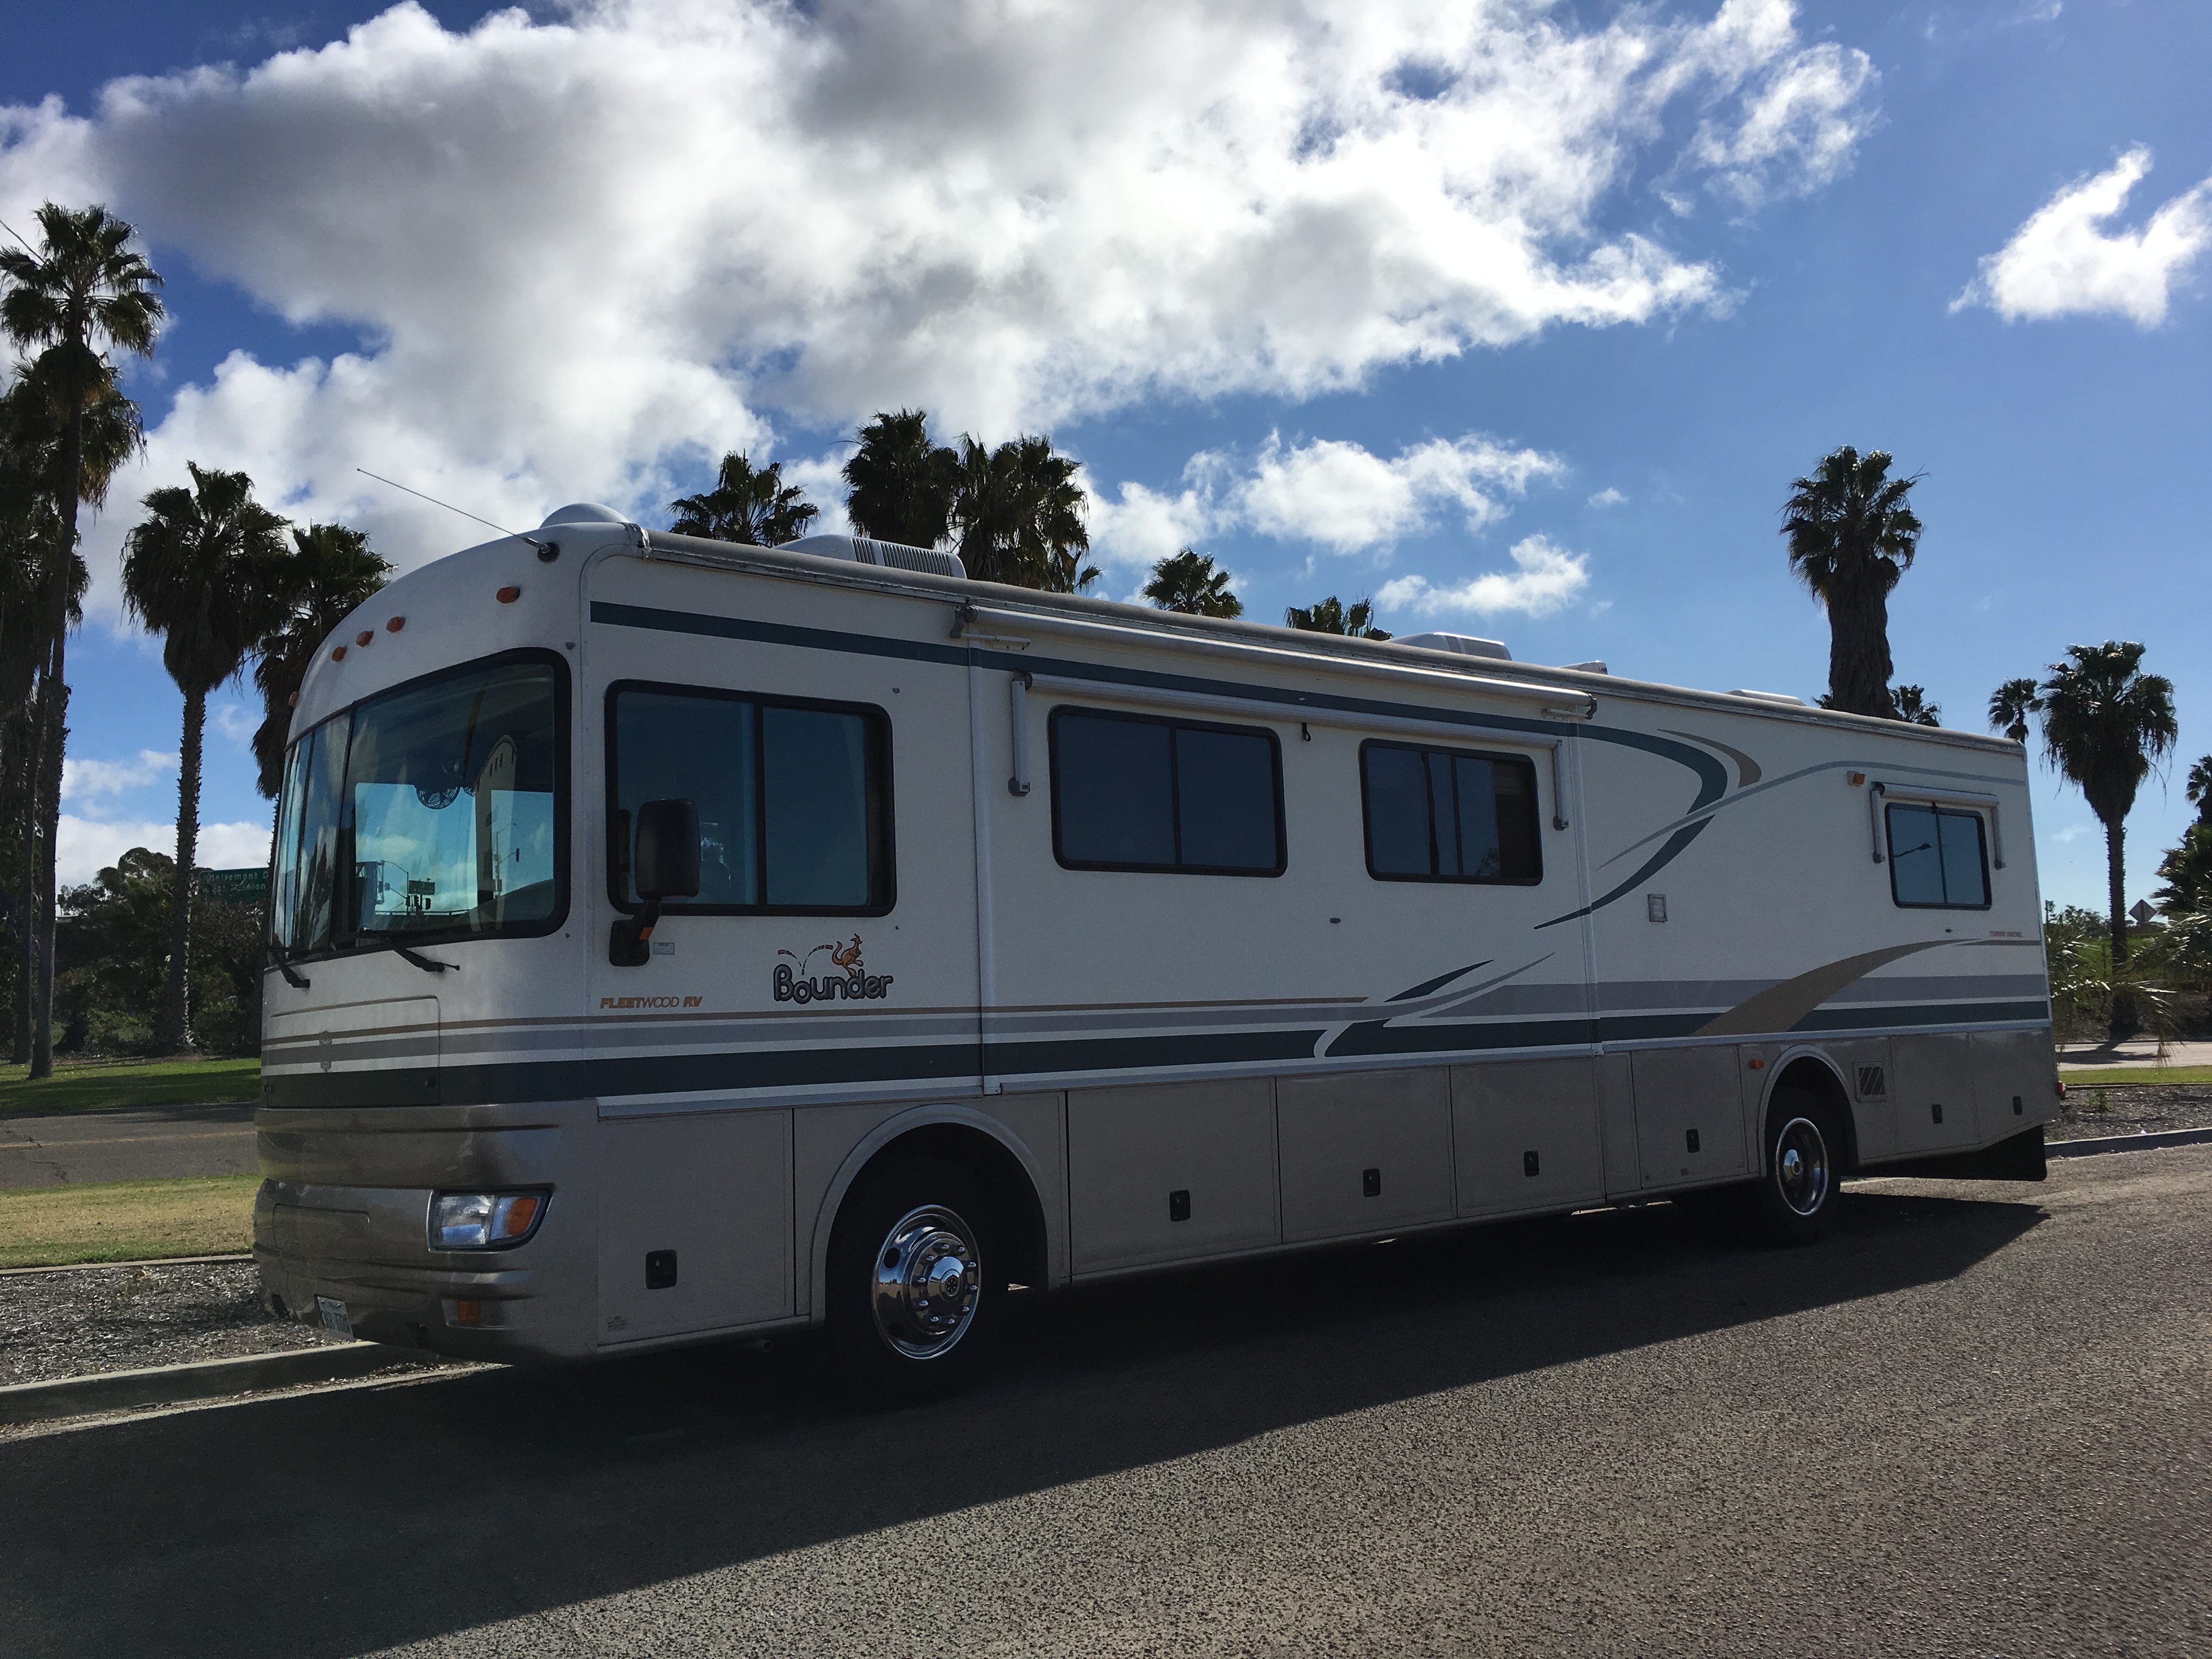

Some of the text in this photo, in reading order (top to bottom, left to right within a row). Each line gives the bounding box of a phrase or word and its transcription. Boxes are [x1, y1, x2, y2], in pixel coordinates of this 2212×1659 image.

[774, 963, 894, 1004] Bounder
[600, 996, 703, 1008] FLEETWOOD RV
